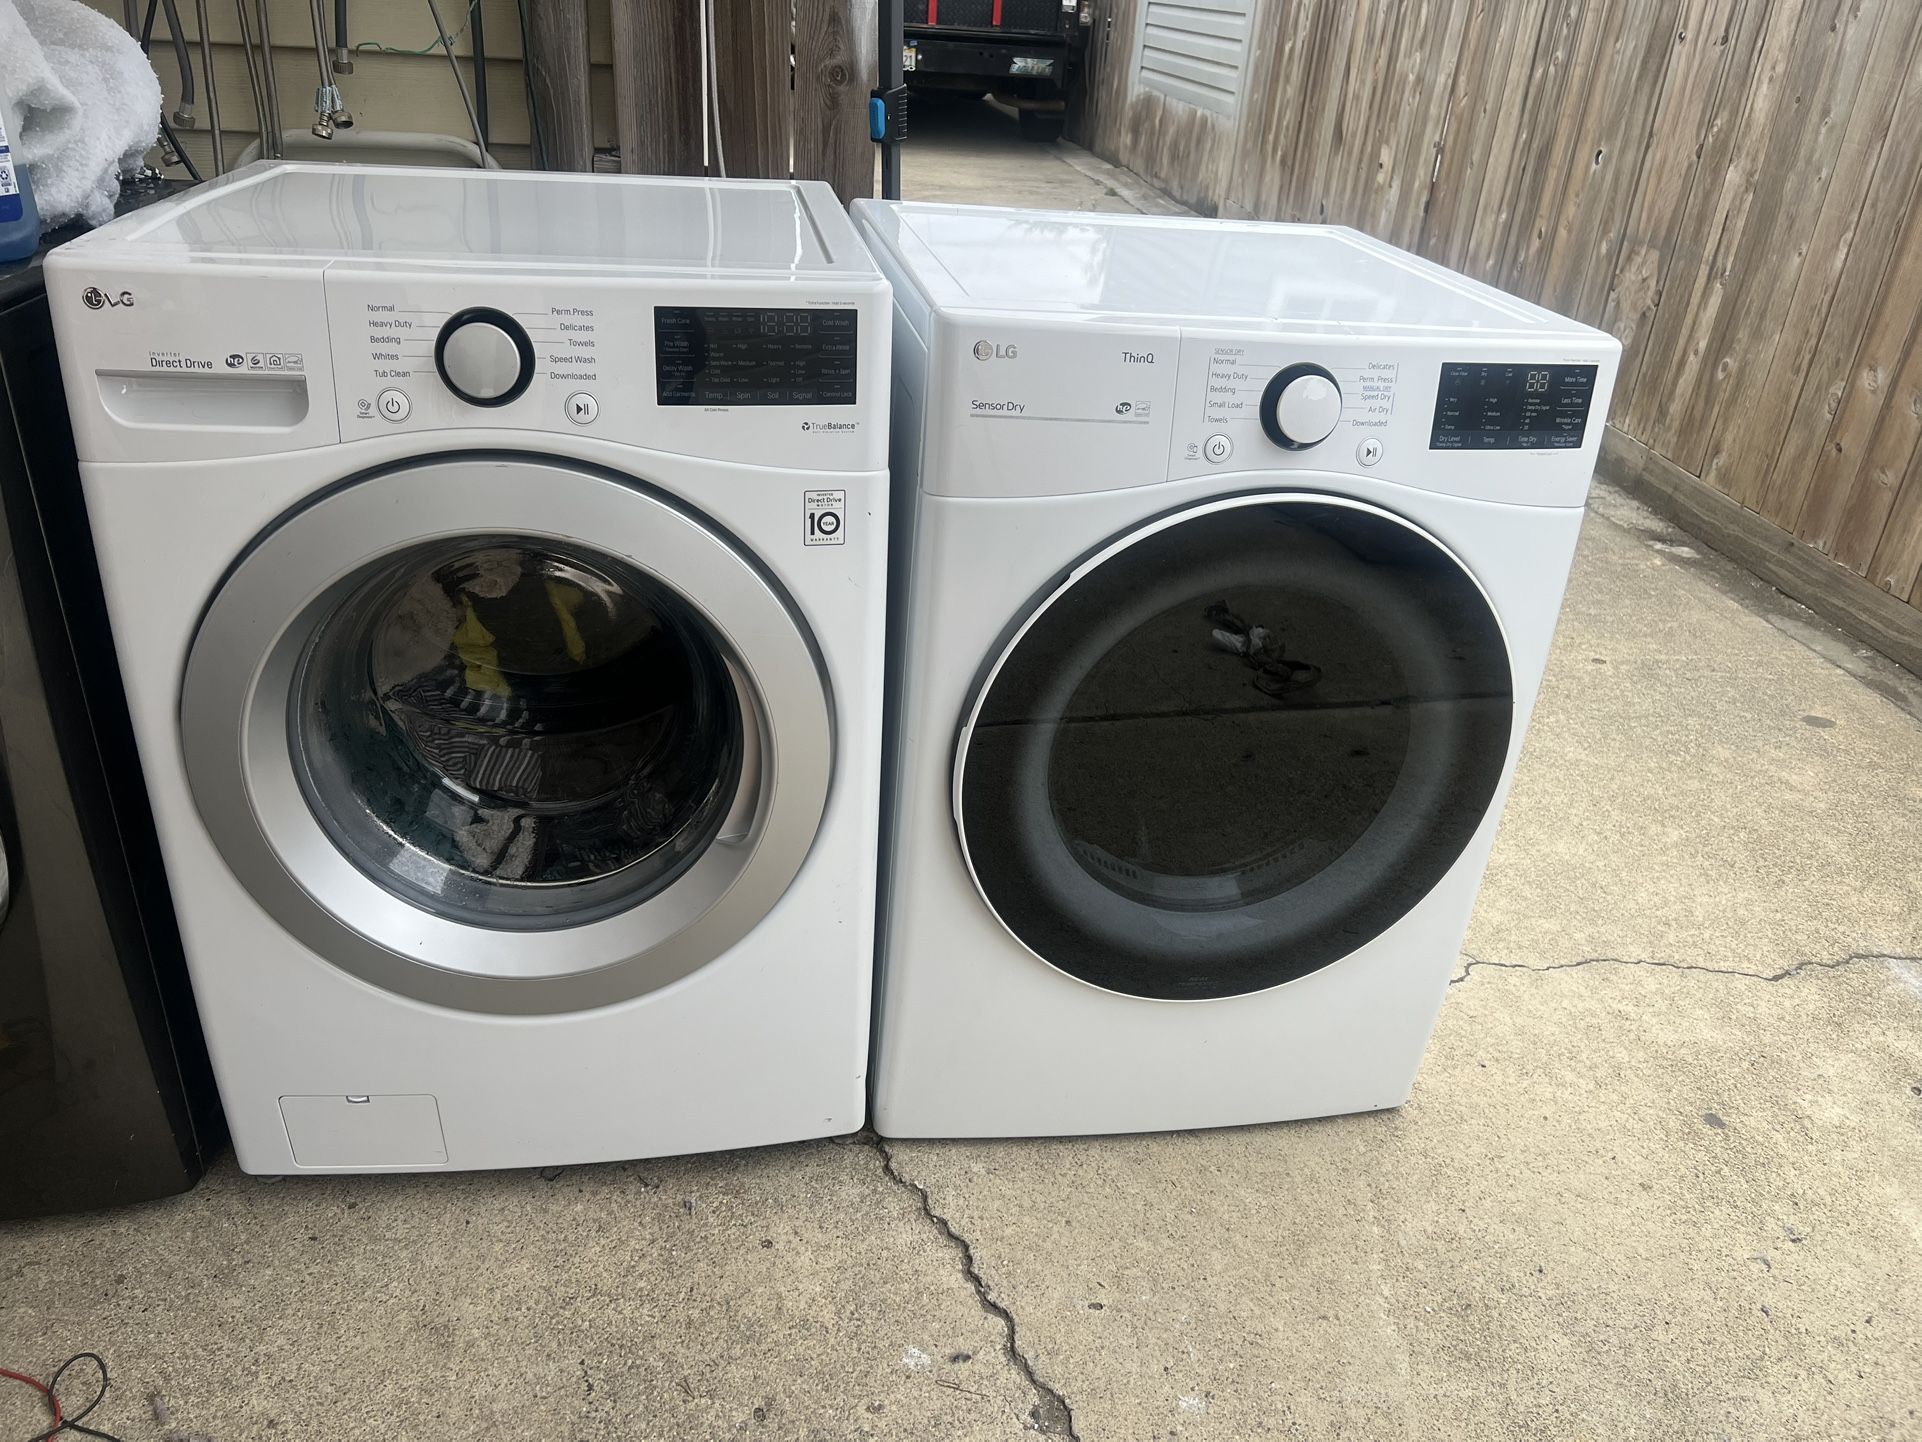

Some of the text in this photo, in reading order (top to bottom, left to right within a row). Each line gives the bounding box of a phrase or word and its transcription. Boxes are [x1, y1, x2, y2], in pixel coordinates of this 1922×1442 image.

[104, 291, 134, 307] LG
[367, 304, 395, 312] Normal
[368, 320, 413, 329] Heavy Duty
[559, 323, 595, 332] Delicates
[370, 335, 401, 345] Bedding
[568, 338, 595, 347] Towels
[995, 344, 1018, 359] LG
[371, 353, 400, 361] Whites
[549, 355, 596, 364] Speed Wash
[1121, 352, 1155, 364] ThinQ
[1212, 357, 1237, 365] Normal
[150, 357, 213, 369] Direct Drive
[1368, 362, 1395, 370] Delicates
[374, 369, 411, 378] Tub Clean
[550, 371, 597, 381] Downloaded
[1211, 372, 1248, 382] Heavy Duty
[1209, 385, 1236, 395] Bedding
[736, 391, 751, 400] Spin
[767, 391, 779, 399] Soil
[792, 391, 813, 401] Signal
[1361, 392, 1391, 402] Speed Dry
[1208, 400, 1243, 409] Small Load
[1378, 406, 1389, 415] Dry
[1207, 415, 1228, 424] Towels
[1352, 419, 1388, 427] Downloaded
[1528, 435, 1537, 443] Dry
[809, 511, 840, 535] 10
